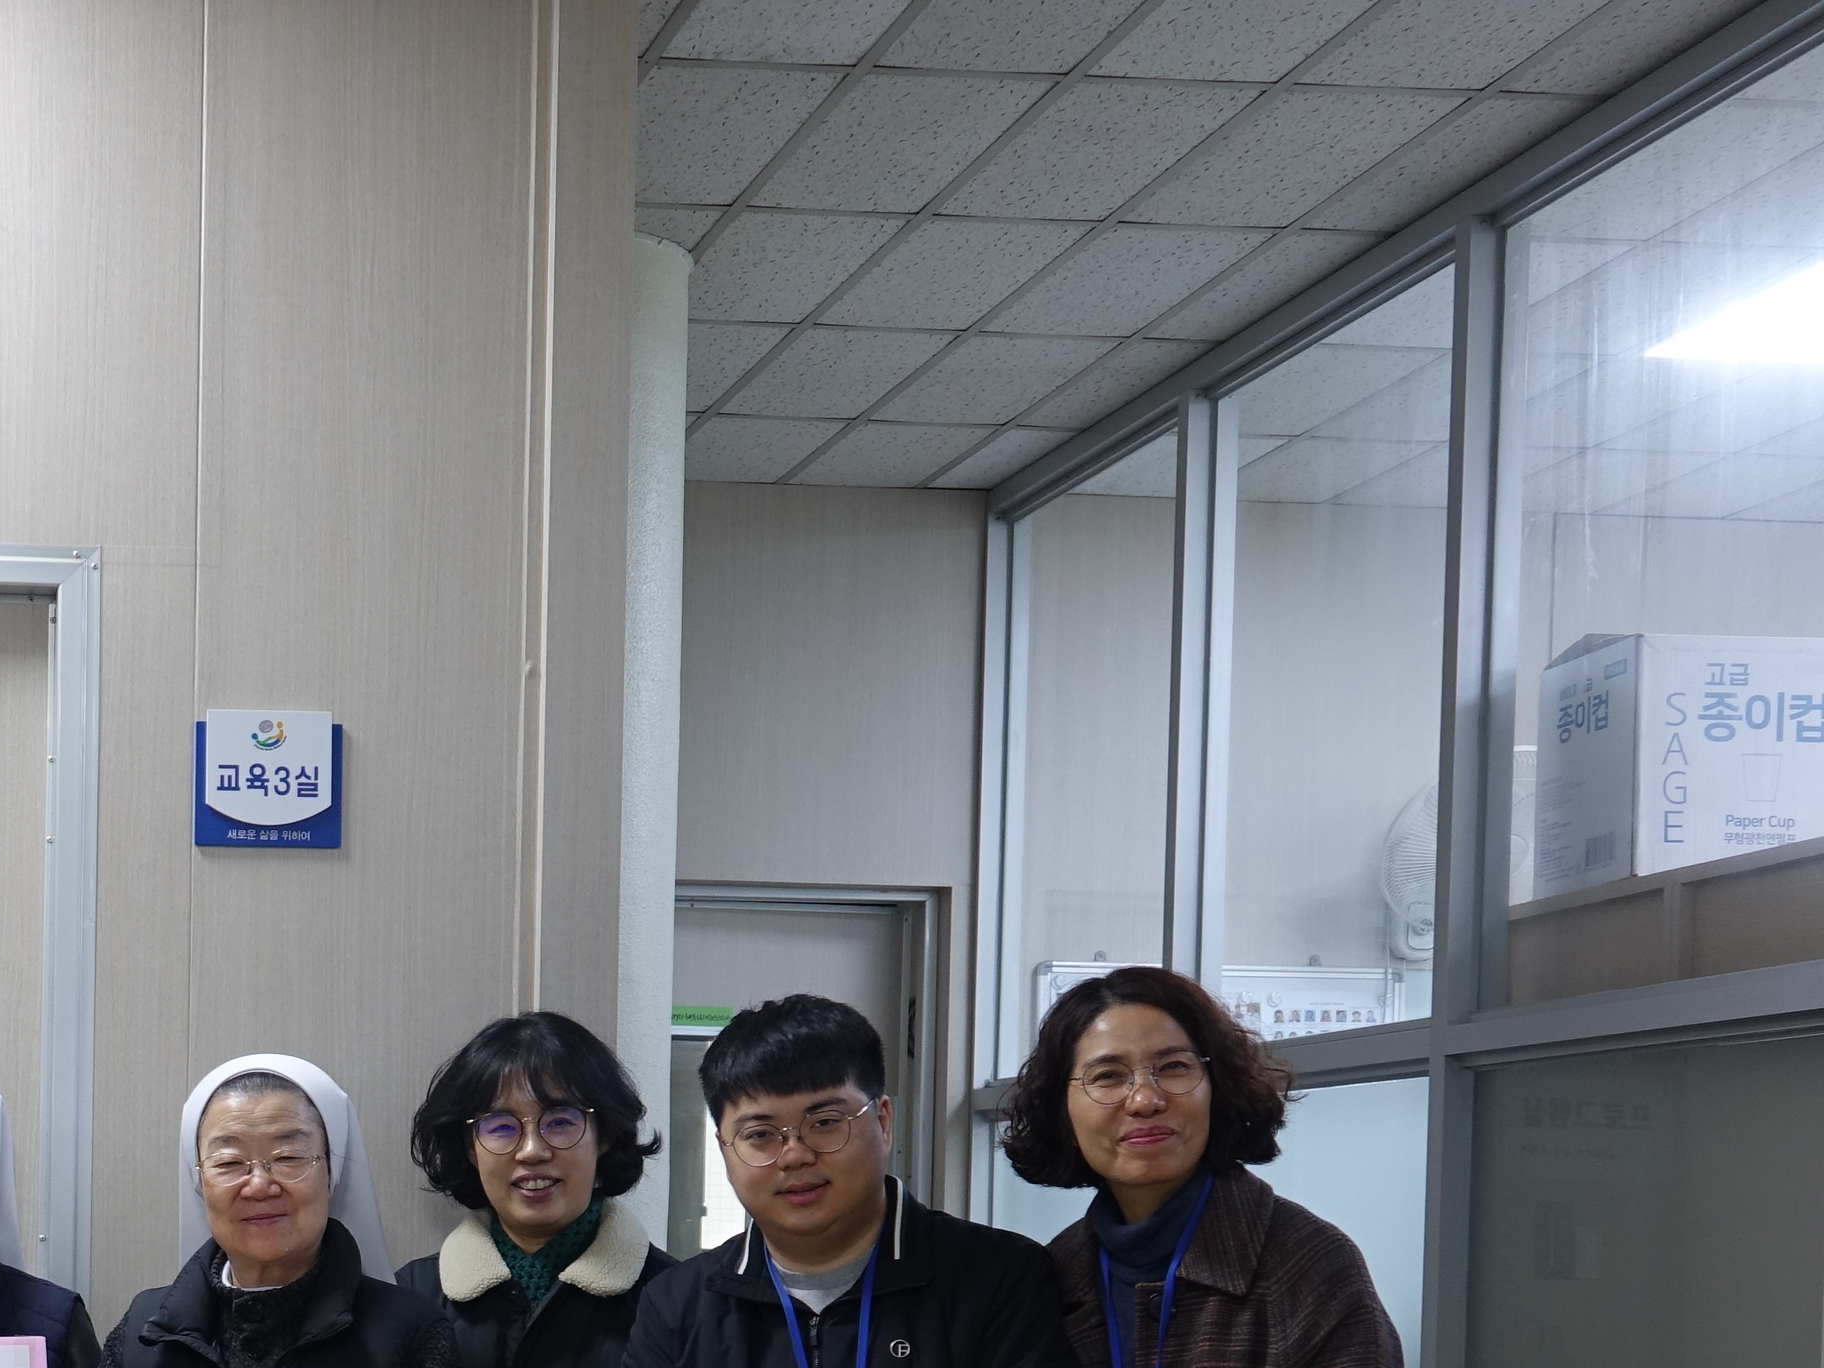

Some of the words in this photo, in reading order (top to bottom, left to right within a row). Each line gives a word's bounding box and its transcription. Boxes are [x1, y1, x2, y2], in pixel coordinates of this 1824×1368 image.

[1704, 662, 1750, 687] 고급
[1697, 691, 1824, 743] 종이컵
[216, 763, 319, 798] 교육3실
[1661, 691, 1689, 844] SAGE
[227, 829, 257, 840] 새로운
[259, 829, 279, 840] 삶을
[281, 831, 311, 842] 위하여
[1725, 814, 1766, 829] Paper
[1768, 814, 1795, 829] Cup
